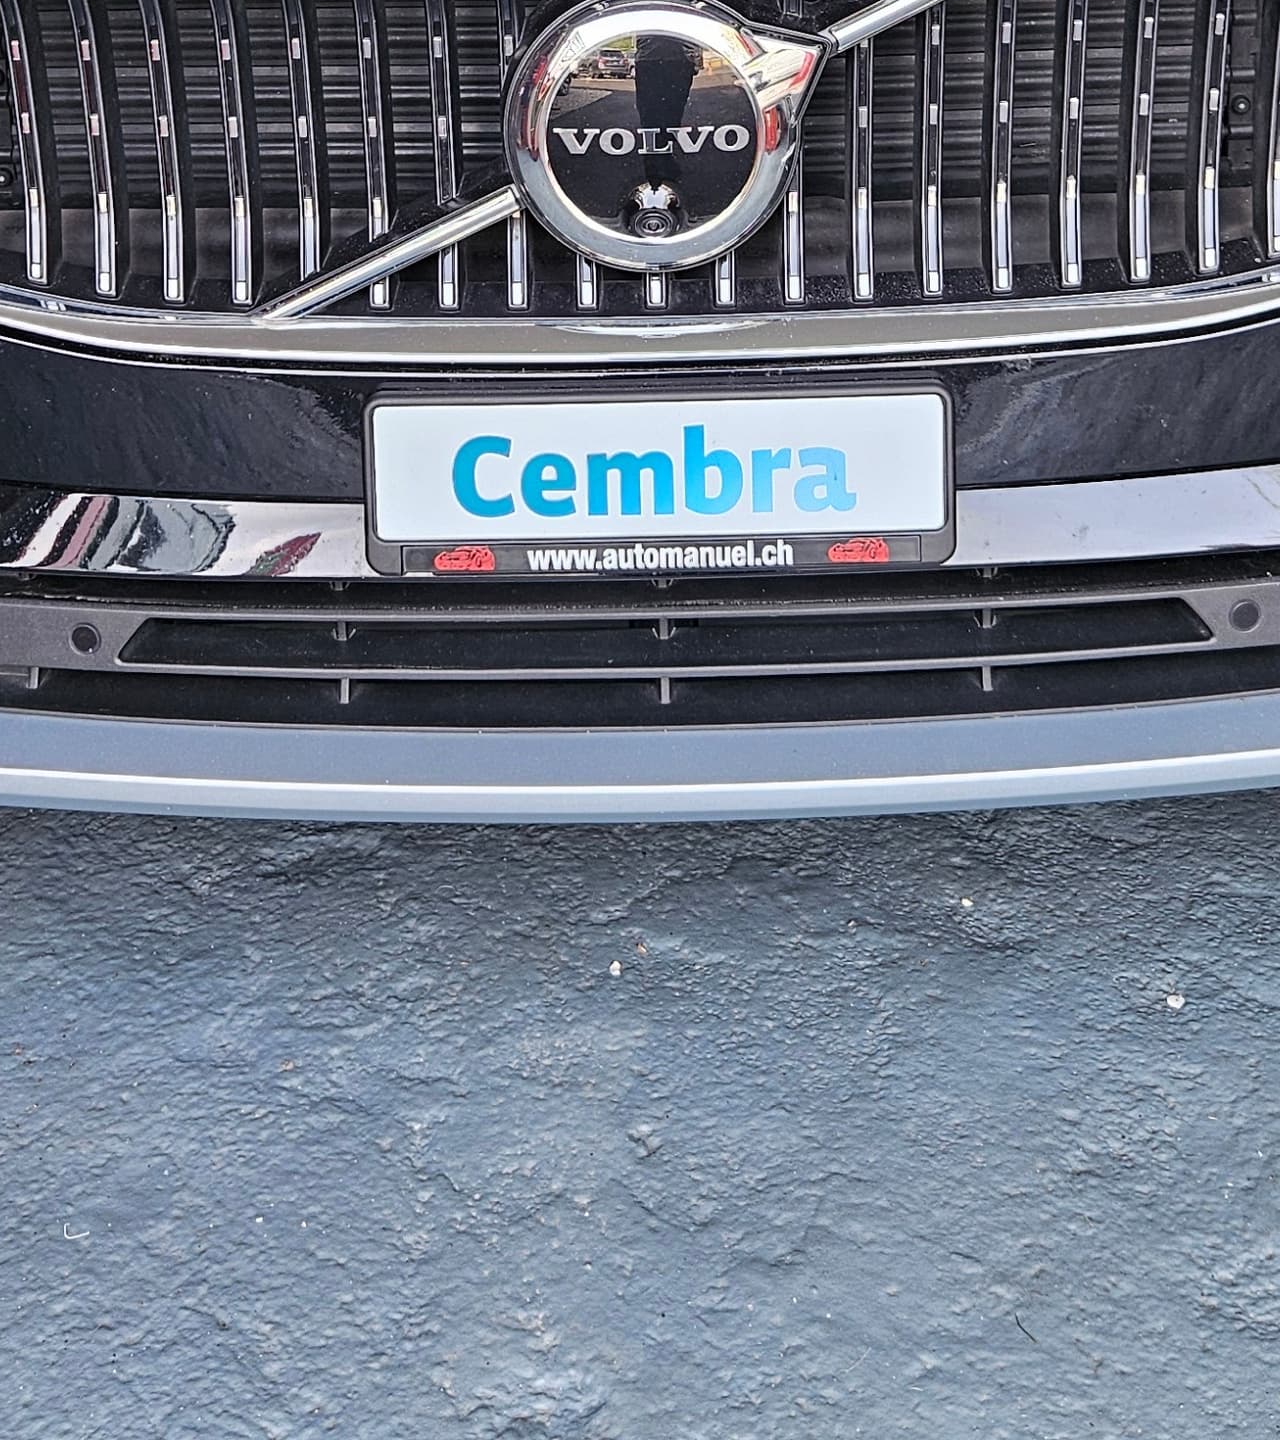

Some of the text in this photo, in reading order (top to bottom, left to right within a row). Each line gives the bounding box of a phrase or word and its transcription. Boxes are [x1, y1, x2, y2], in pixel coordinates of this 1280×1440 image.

[553, 123, 750, 156] VOLVO
[452, 424, 857, 518] Cembra
[527, 539, 794, 572] www.automanuel.ch
